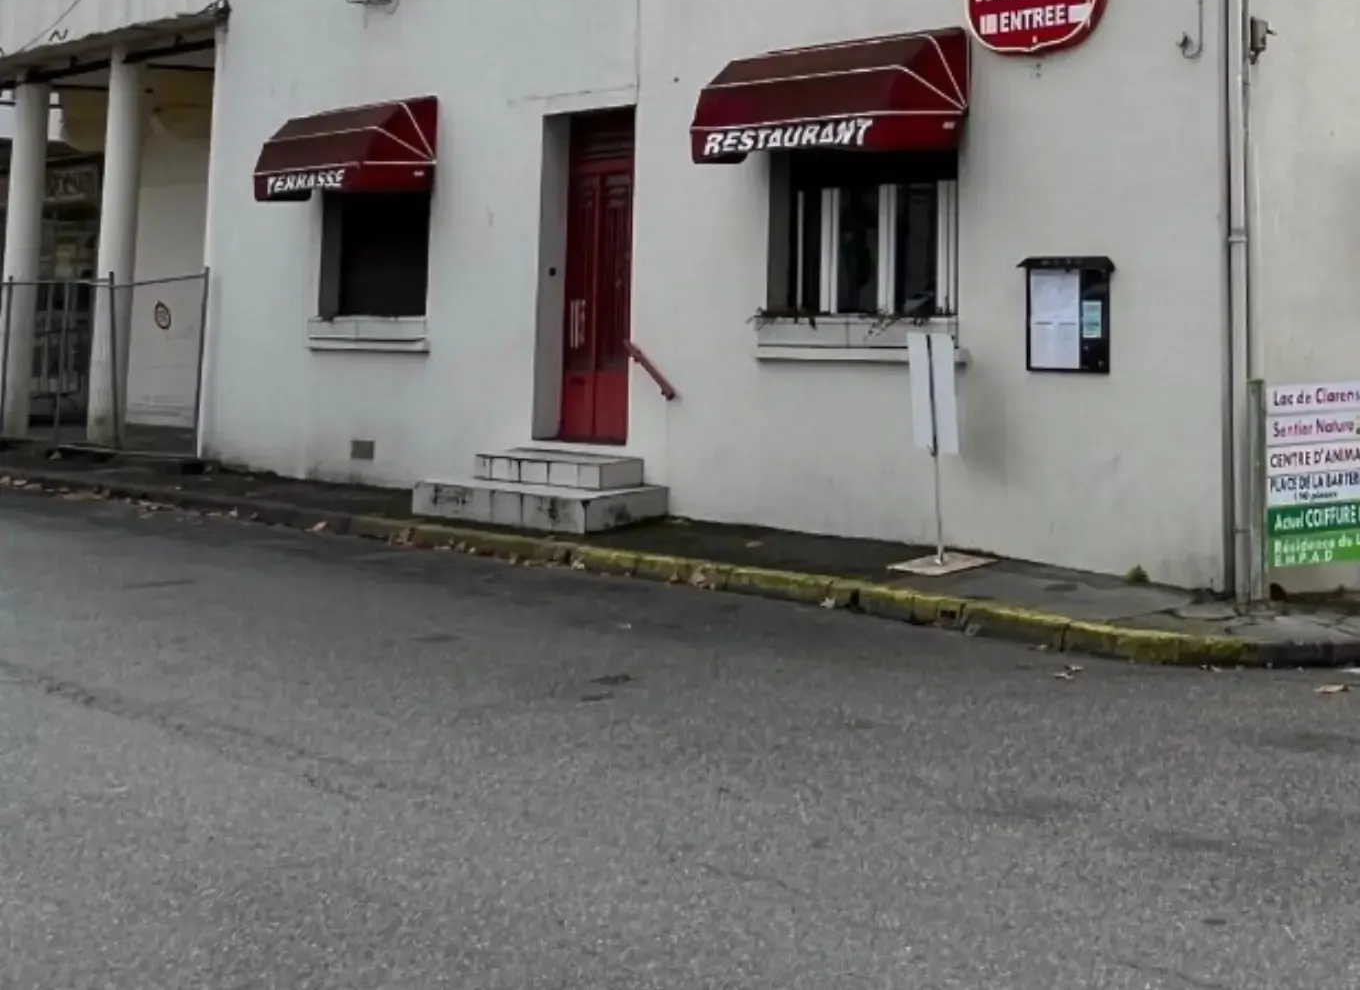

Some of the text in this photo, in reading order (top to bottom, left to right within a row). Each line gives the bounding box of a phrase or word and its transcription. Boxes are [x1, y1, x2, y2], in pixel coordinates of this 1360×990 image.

[1000, 3, 1067, 33] ENTREE
[704, 118, 873, 156] RESTAURANT
[266, 169, 345, 196] TERRASSE
[1273, 390, 1293, 406] Lac
[1296, 390, 1312, 404] de
[1273, 421, 1313, 438] Sentier
[1270, 451, 1312, 468] CENTRE
[1305, 505, 1357, 528] COIFFURE
